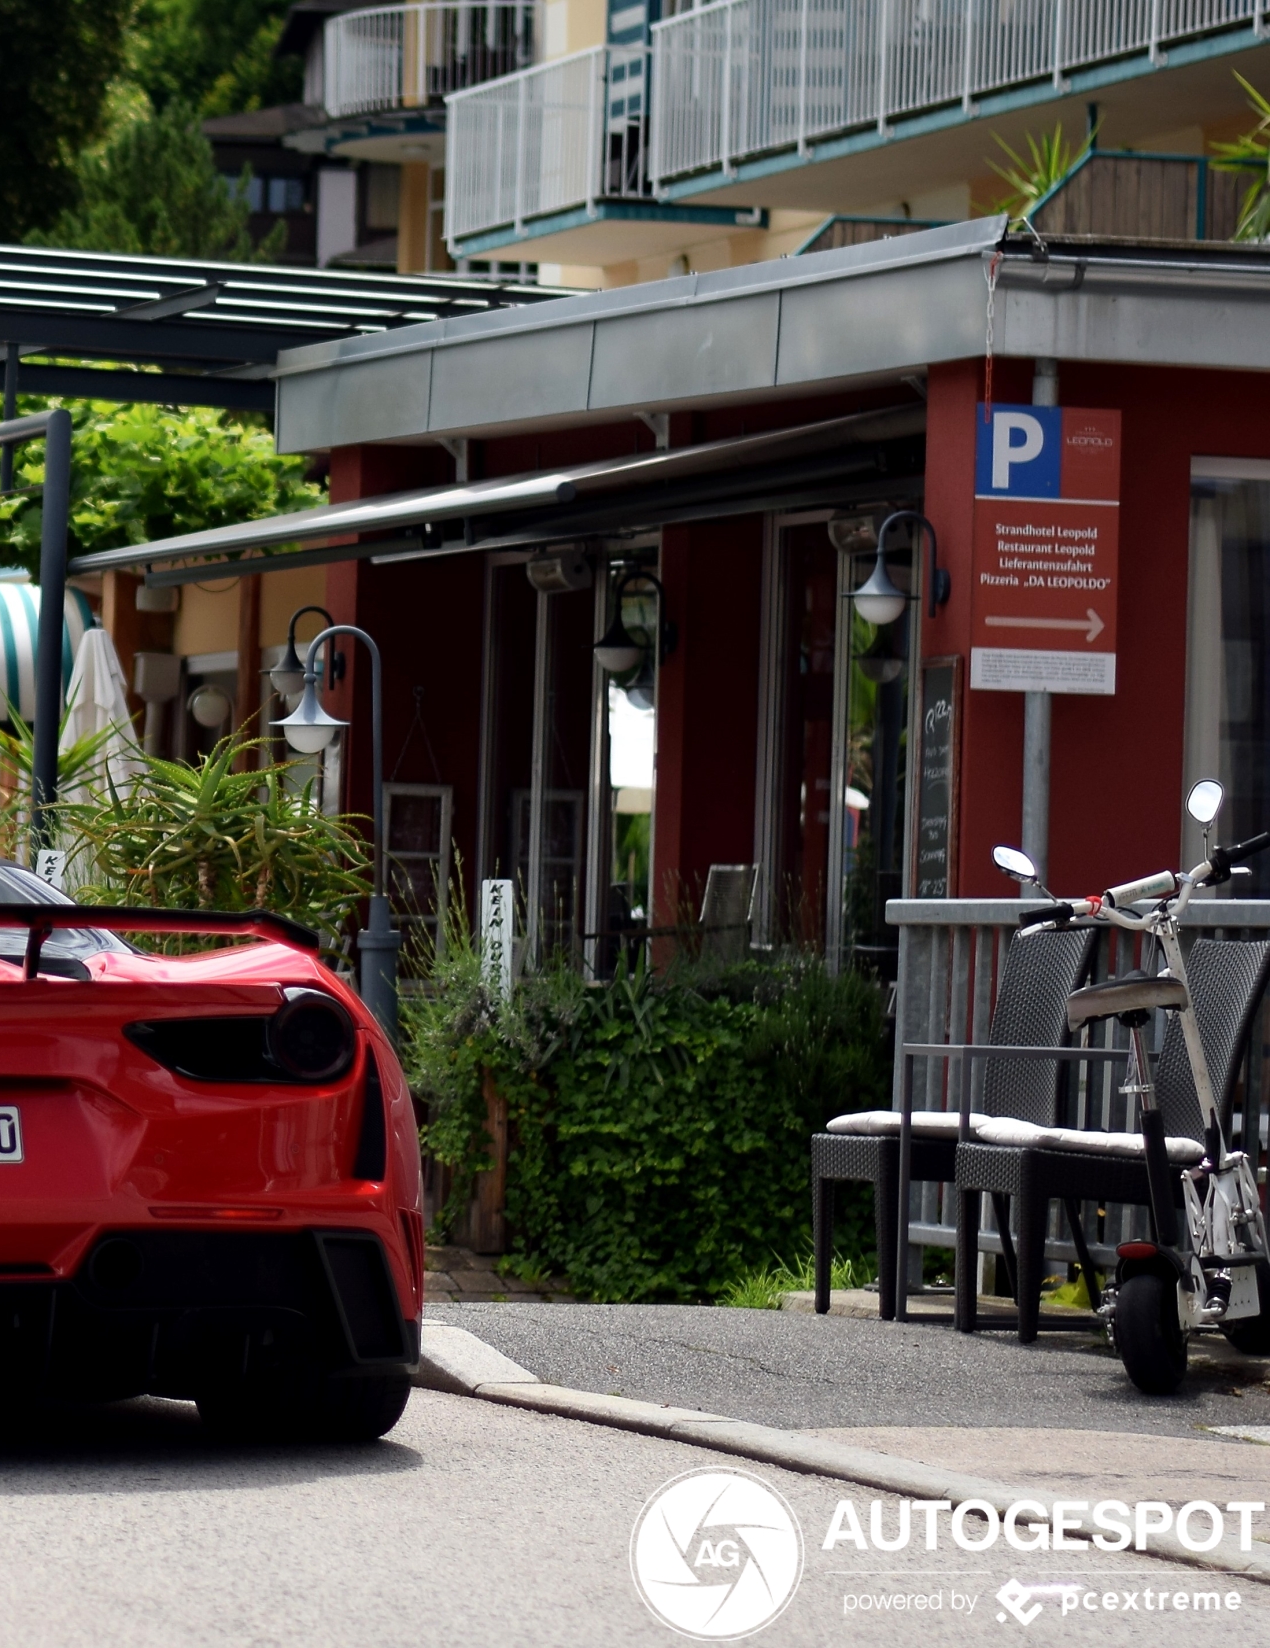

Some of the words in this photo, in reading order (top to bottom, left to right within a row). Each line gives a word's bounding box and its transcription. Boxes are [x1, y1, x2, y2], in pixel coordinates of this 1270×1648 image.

[992, 412, 1044, 489] P
[995, 523, 1055, 537] Strandhotel
[1057, 526, 1098, 540] Leopold
[997, 540, 1053, 554] Restaurant
[1054, 543, 1095, 557] Leopold
[999, 557, 1093, 573] Lieferantenzufahrt
[980, 573, 1019, 586] Pizzeria
[489, 884, 504, 928] KEIN
